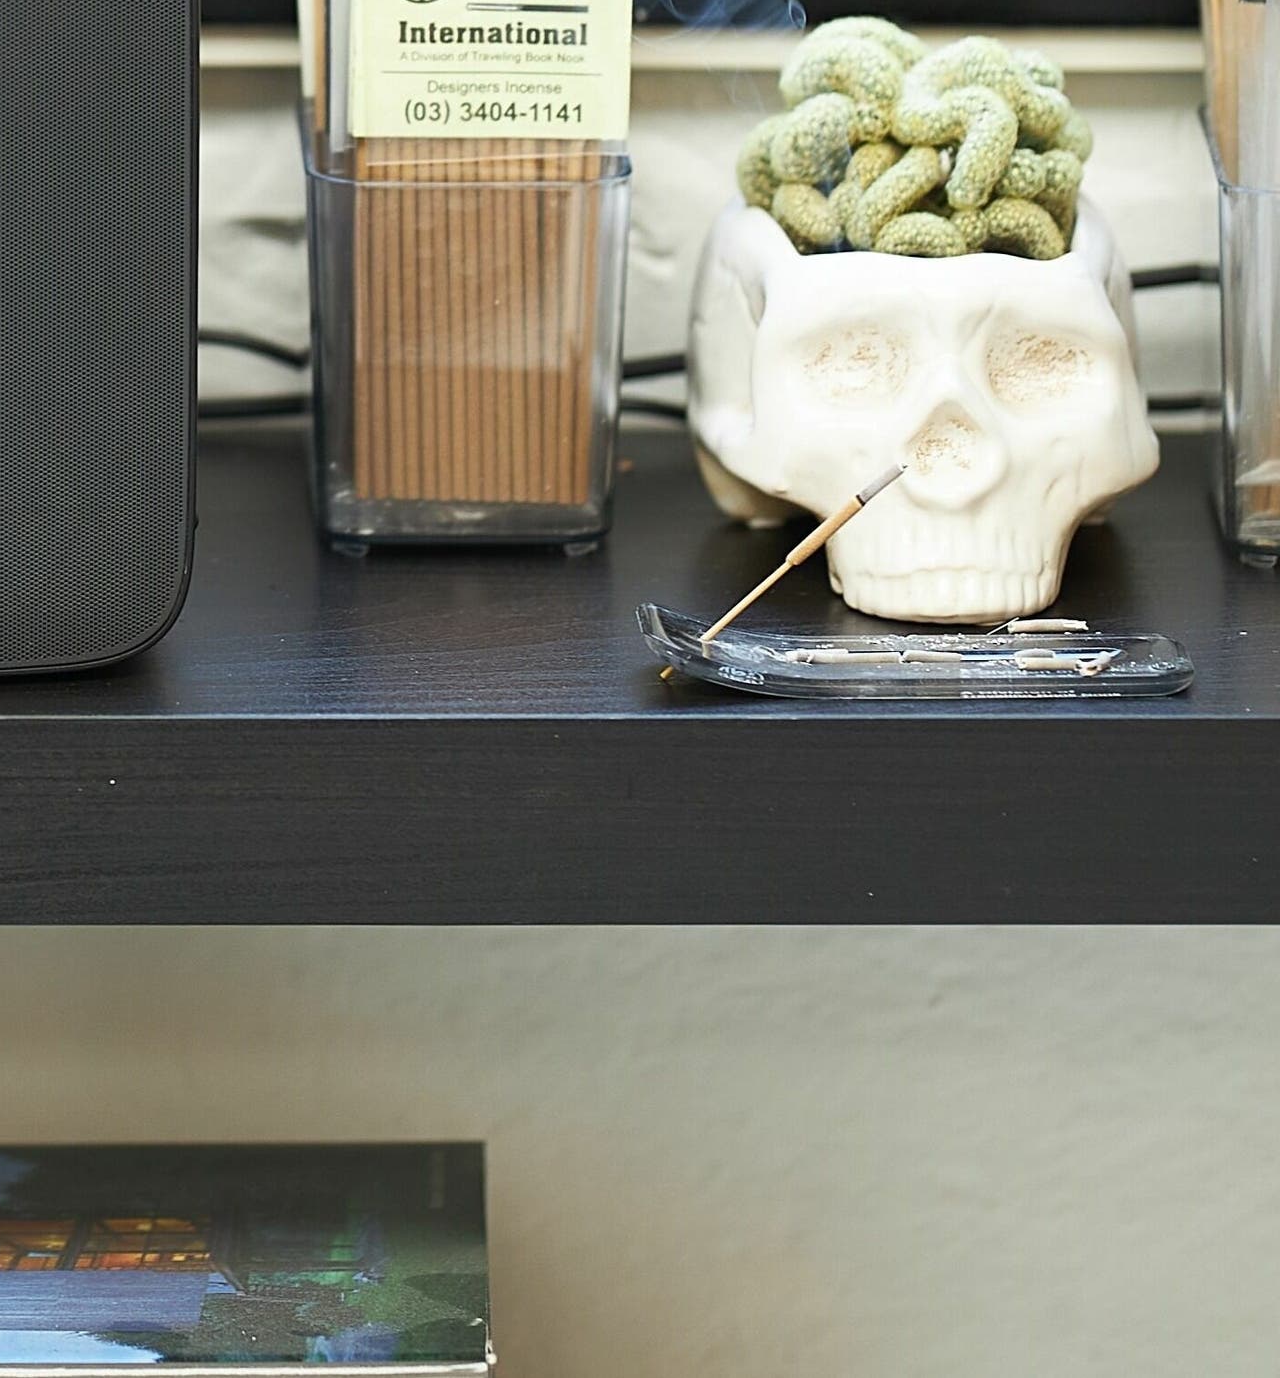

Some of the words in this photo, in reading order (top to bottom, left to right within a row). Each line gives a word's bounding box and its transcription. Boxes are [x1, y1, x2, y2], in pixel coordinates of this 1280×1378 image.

[399, 21, 588, 46] International
[400, 52, 408, 62] A
[411, 51, 454, 62] Division
[458, 52, 468, 62] of
[472, 51, 522, 64] Traveling
[525, 52, 552, 62] Book
[427, 80, 500, 95] Designers
[505, 81, 562, 94] Incense
[405, 100, 450, 124] (03)
[460, 102, 582, 123] 3404-1141
